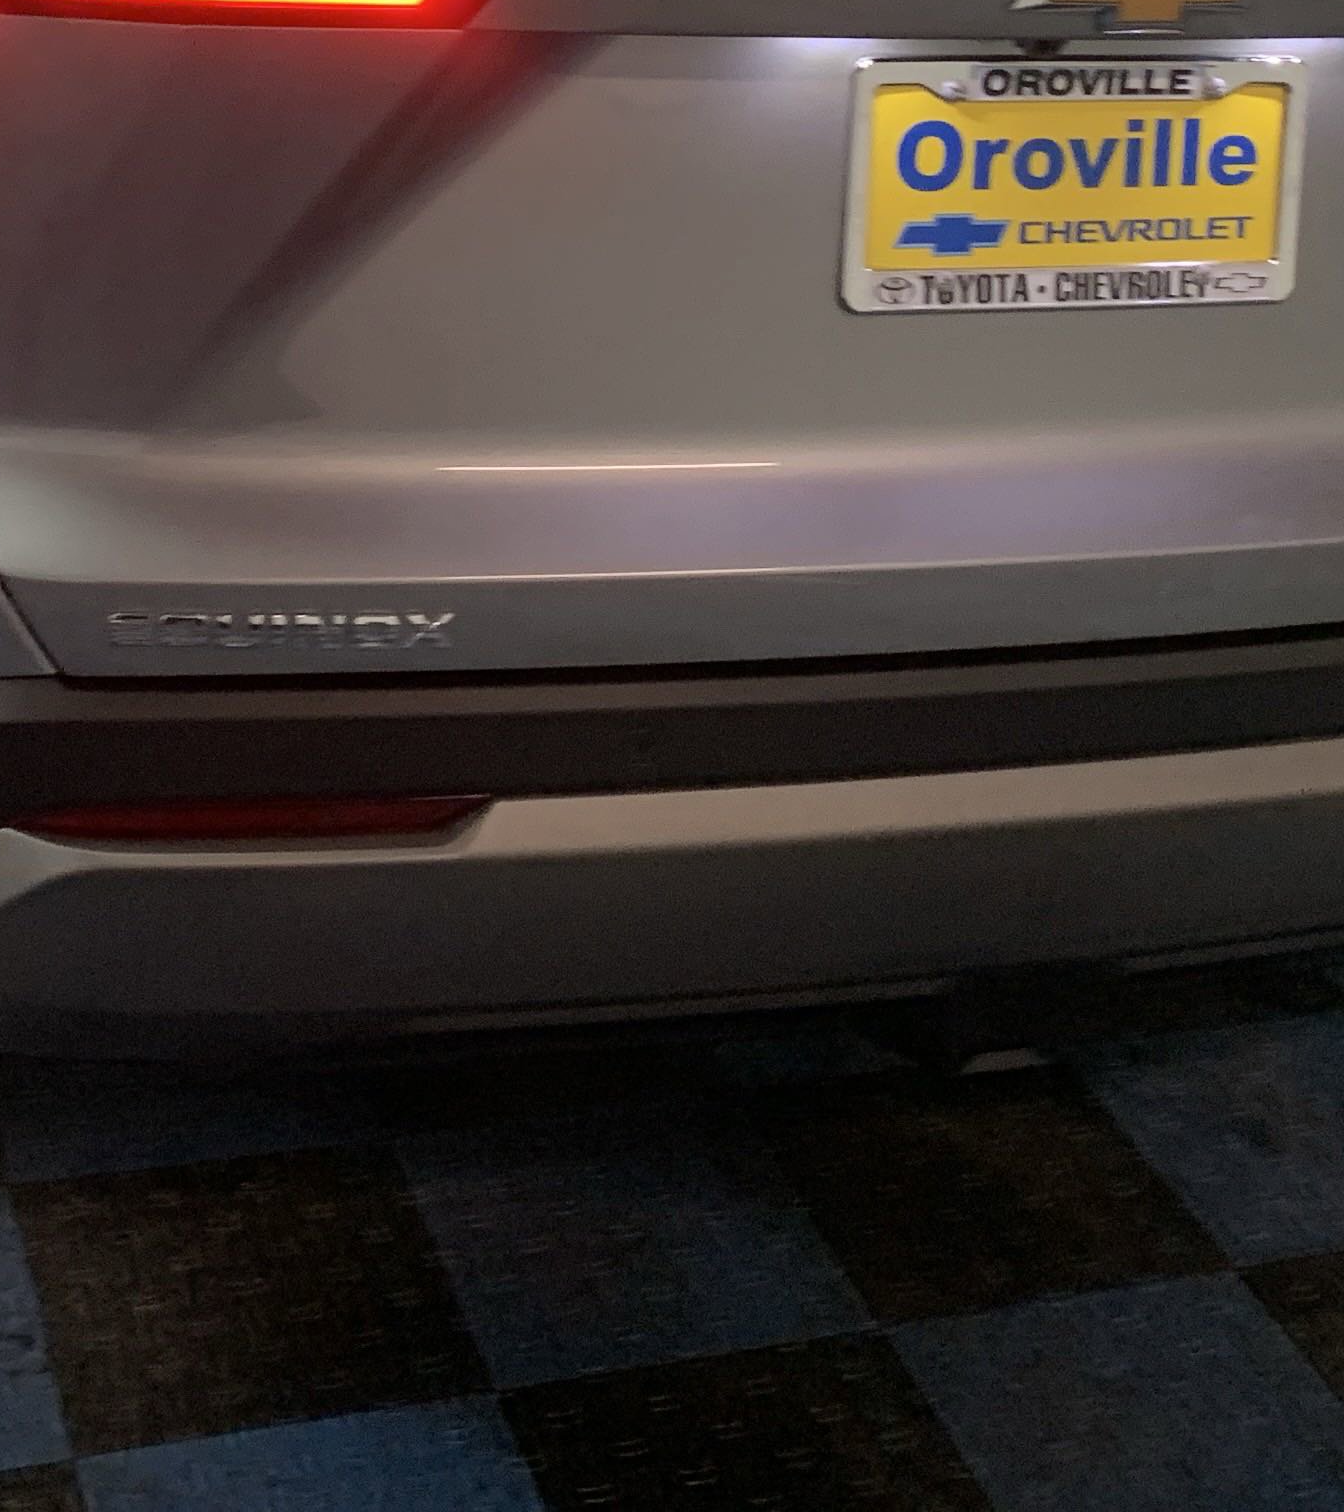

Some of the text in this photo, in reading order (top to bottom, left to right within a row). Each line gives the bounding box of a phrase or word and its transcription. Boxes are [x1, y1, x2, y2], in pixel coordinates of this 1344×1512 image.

[981, 68, 1193, 97] OROVILLE
[897, 118, 1258, 192] Oroville
[1018, 216, 1254, 245] CHEVROLET
